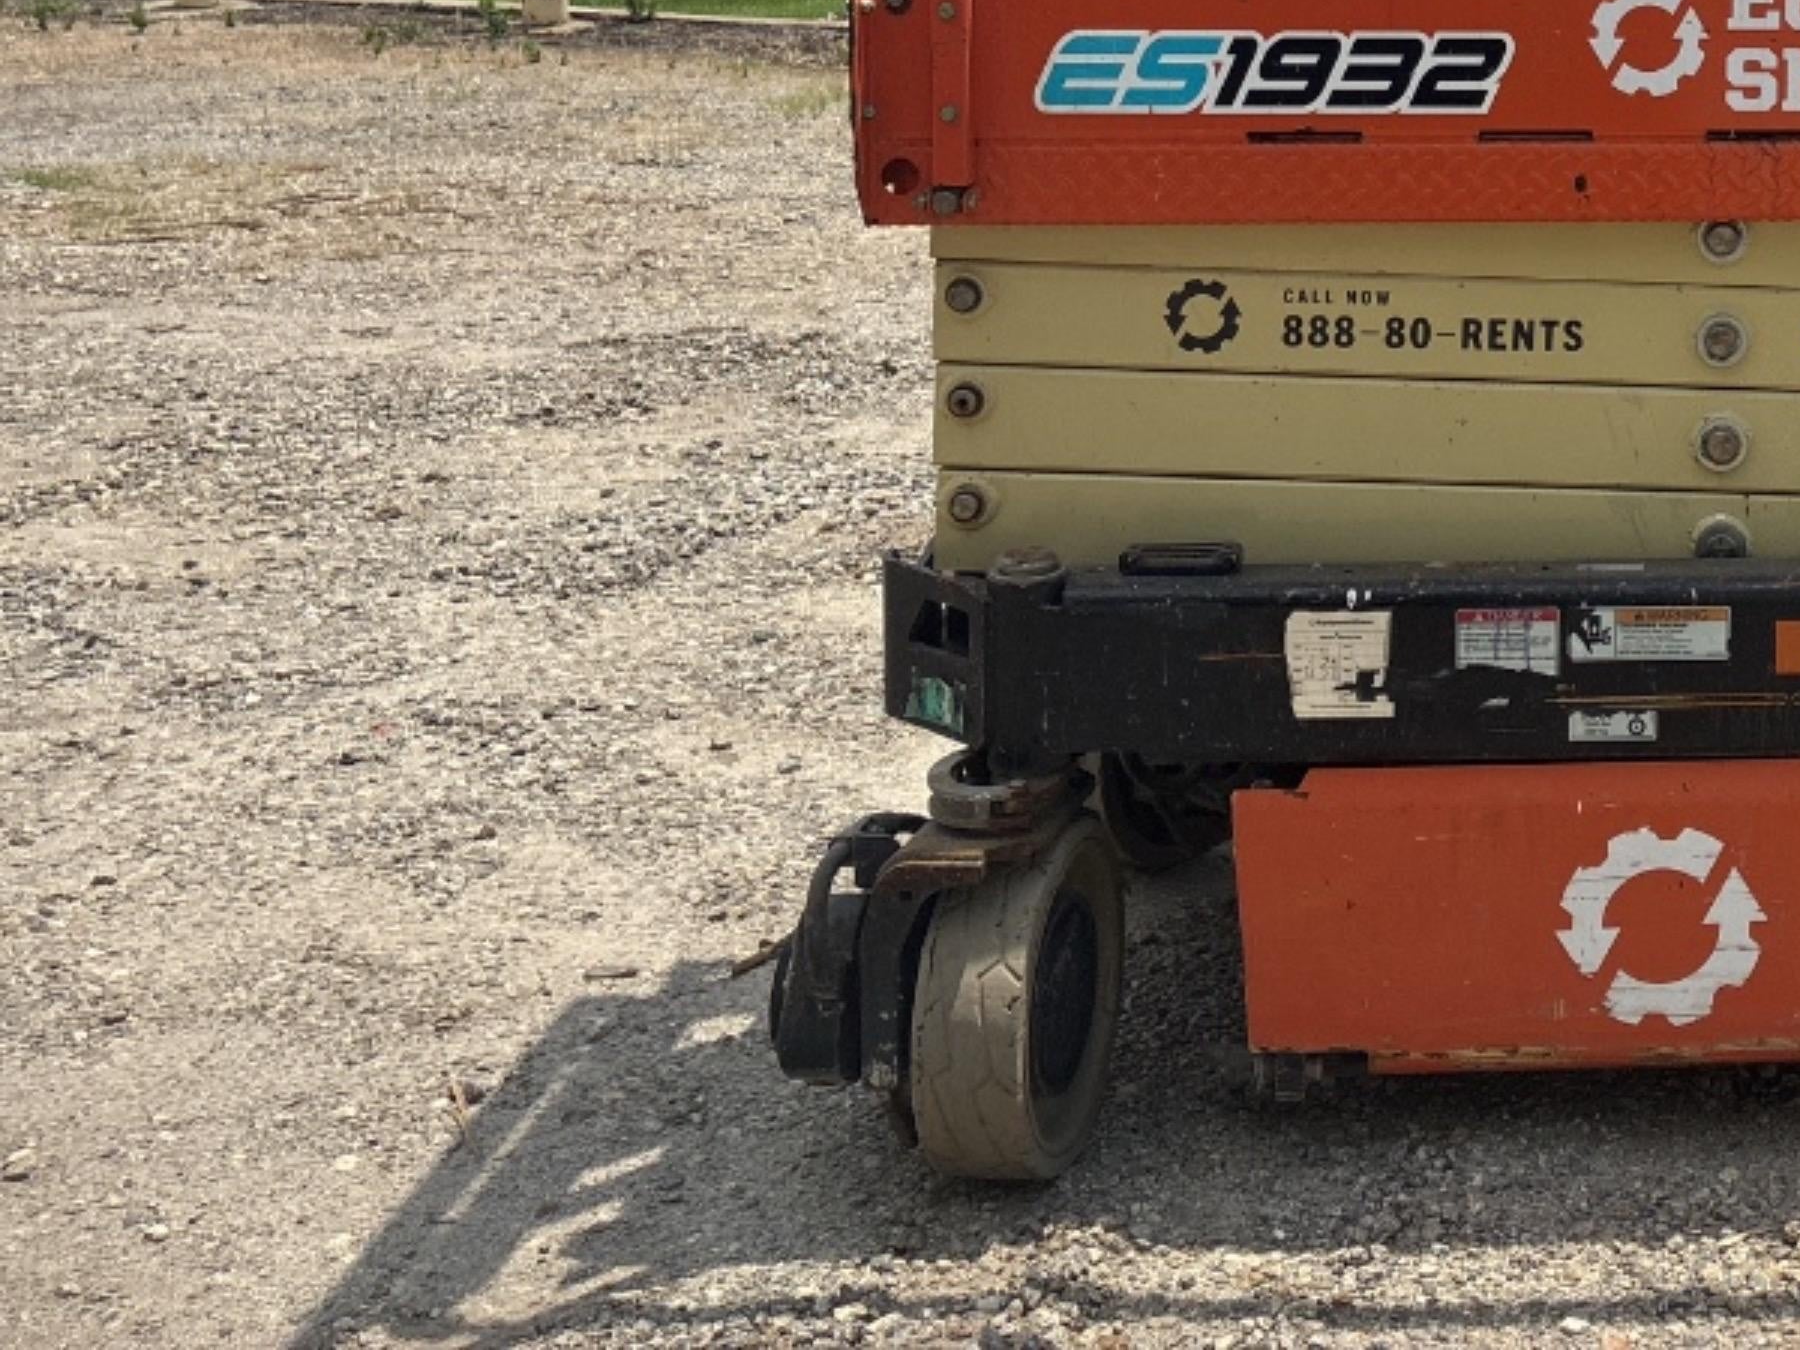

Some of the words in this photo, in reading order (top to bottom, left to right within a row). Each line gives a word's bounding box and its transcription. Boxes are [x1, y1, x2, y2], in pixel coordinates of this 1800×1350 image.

[1034, 30, 1515, 114] ES1932
[1283, 288, 1332, 305] CALL
[1346, 289, 1391, 306] NOW
[1282, 314, 1584, 351] 888-80-RENTS
